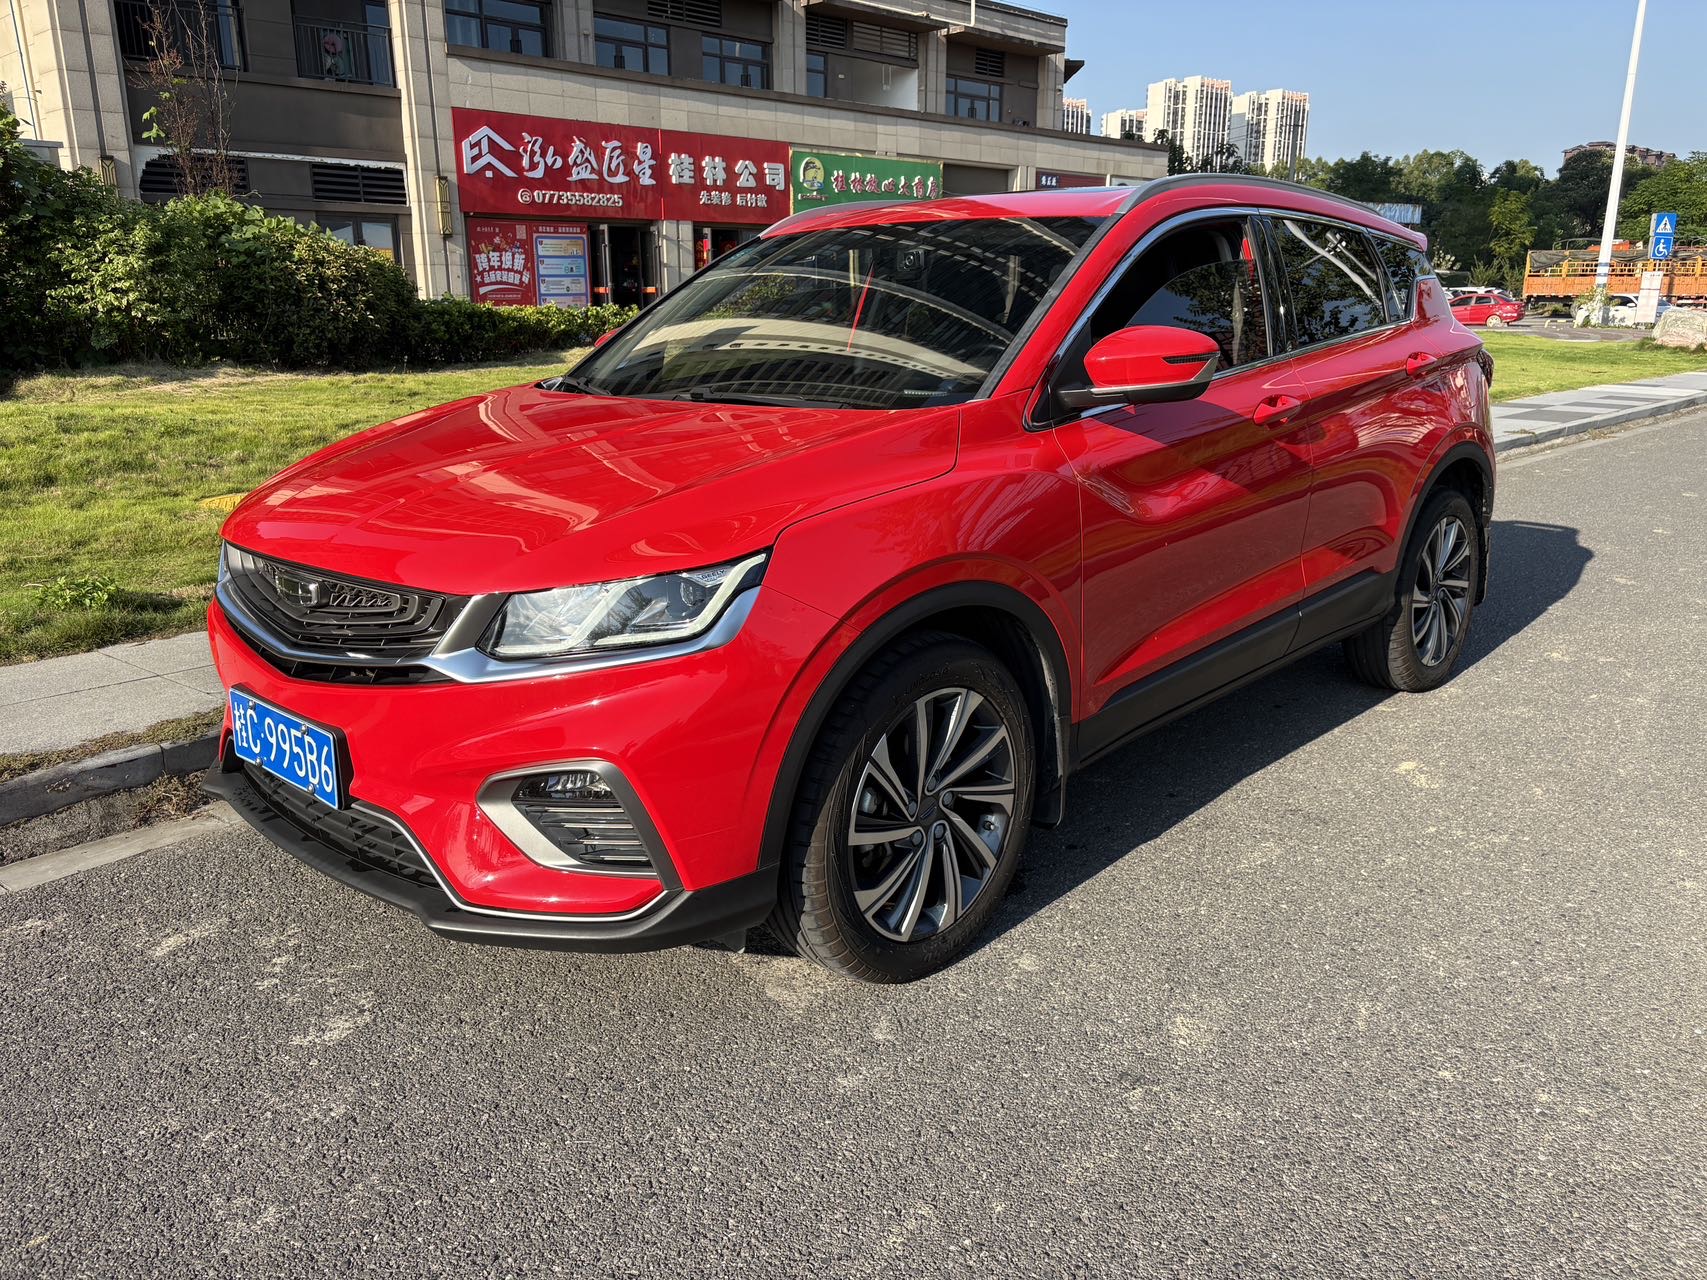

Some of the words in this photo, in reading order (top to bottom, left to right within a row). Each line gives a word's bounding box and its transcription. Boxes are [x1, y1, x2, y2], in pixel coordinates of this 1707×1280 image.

[668, 152, 786, 191] 桂林公司
[533, 190, 624, 207] 07735582825
[699, 190, 732, 206] 先装修
[736, 192, 768, 208] 后付款
